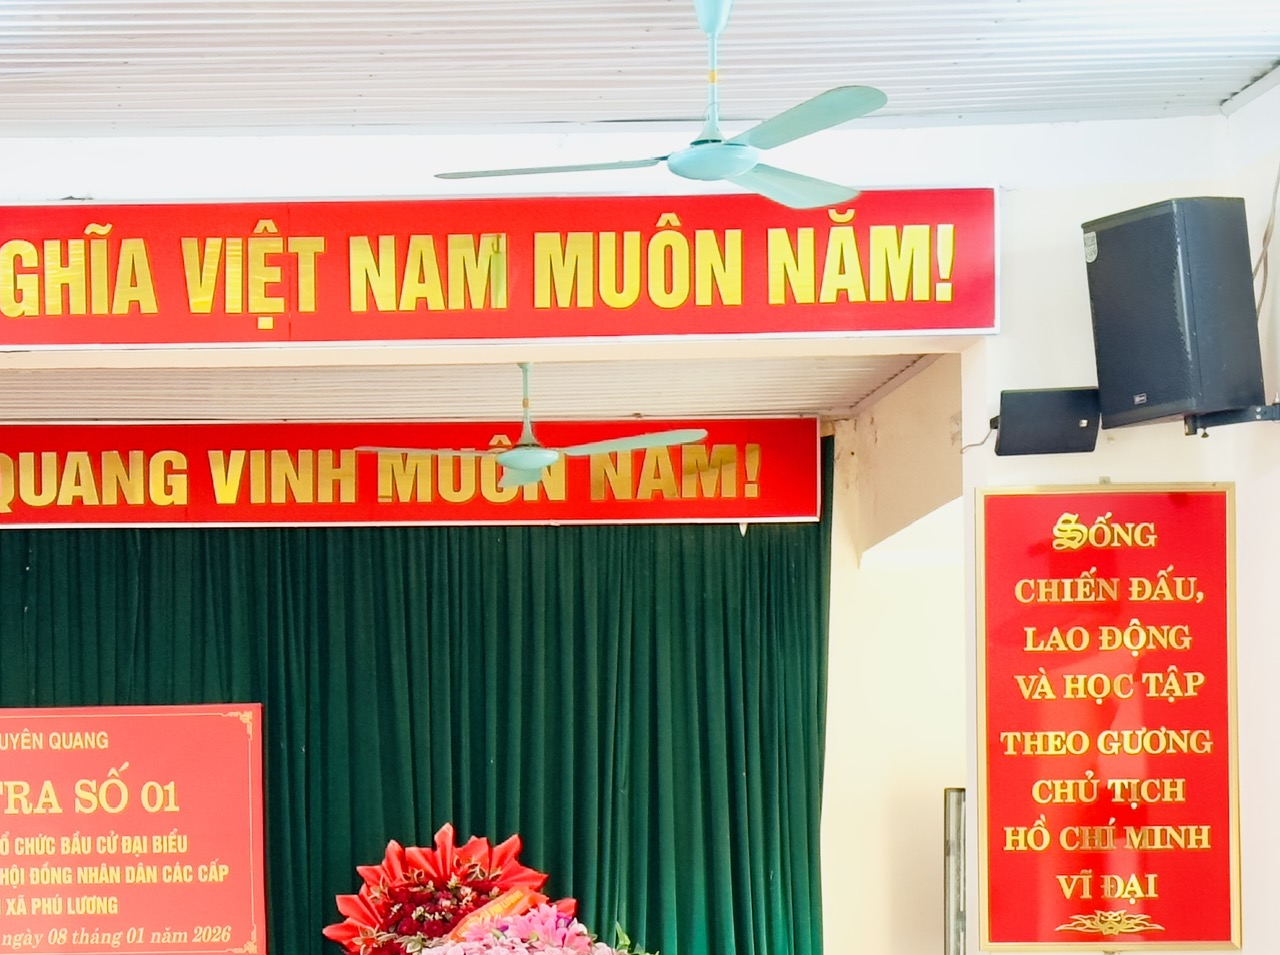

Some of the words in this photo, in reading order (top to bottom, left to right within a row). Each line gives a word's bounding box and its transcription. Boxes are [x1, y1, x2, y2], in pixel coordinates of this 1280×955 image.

[182, 220, 324, 329] VIỆT
[350, 234, 507, 311] NAM
[535, 213, 741, 308] MUÔN
[768, 208, 954, 305] NĂM!
[208, 449, 356, 505] VINH
[377, 434, 566, 503] MUÔN
[1053, 512, 1157, 549] SỐNG
[1015, 567, 1119, 603] CHIẾN
[1129, 566, 1203, 603] ĐẤU,
[1024, 627, 1089, 651] LAO
[1099, 619, 1191, 657] ĐỘNG
[1015, 668, 1056, 699] VÀ
[1064, 674, 1133, 704] HỌC
[1142, 666, 1204, 702] TẬP
[49, 732, 108, 749] QUANG
[1001, 731, 1089, 754] THEO
[1098, 727, 1212, 754] GƯƠNG
[75, 762, 129, 813] SỐ
[141, 782, 179, 812] 01
[1032, 771, 1099, 803] CHỦ
[1108, 779, 1185, 809] TỊCH
[15, 834, 55, 855] CHỨC
[61, 831, 91, 854] BẦU
[97, 831, 118, 854] CỬ
[122, 836, 147, 857] ĐẠI
[153, 829, 187, 853] BIỂU
[1004, 814, 1050, 850] HỒ
[1059, 818, 1117, 851] CHÍ
[1124, 826, 1210, 850] MINH
[0, 865, 24, 888] HỘI
[30, 862, 72, 884] ĐỒNG
[77, 863, 120, 883] NHÂN
[126, 863, 157, 883] DÂN
[163, 862, 193, 883] CÁC
[198, 859, 228, 882] CẤP
[1056, 870, 1091, 899] VĨ
[1100, 873, 1158, 905] ĐẠI
[6, 895, 27, 915] XÃ
[32, 895, 62, 914] PHÚ
[68, 896, 117, 914] LƯƠNG
[2, 929, 43, 949] ngày
[48, 928, 67, 944] 08
[72, 928, 123, 947] tháng
[127, 928, 143, 943] 01
[150, 928, 187, 943] năm
[192, 926, 231, 942] 2026
